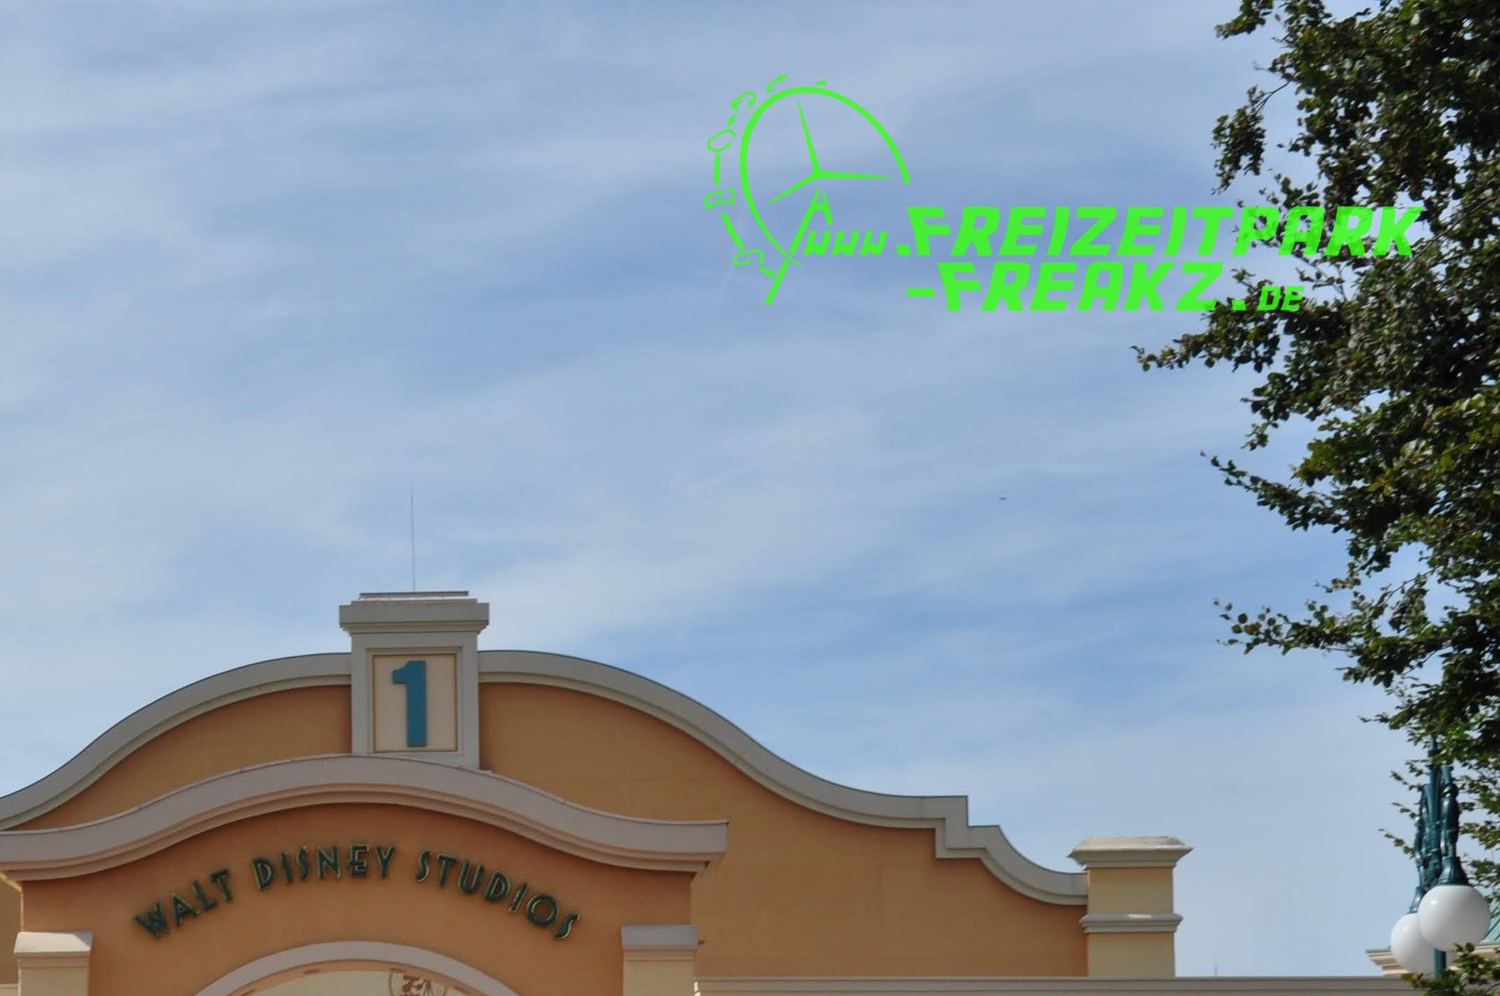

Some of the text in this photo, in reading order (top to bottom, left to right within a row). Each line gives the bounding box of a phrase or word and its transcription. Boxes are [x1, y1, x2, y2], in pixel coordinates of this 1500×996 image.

[392, 660, 427, 747] 1
[135, 843, 580, 940] WALT DISNEY STUDIOS
